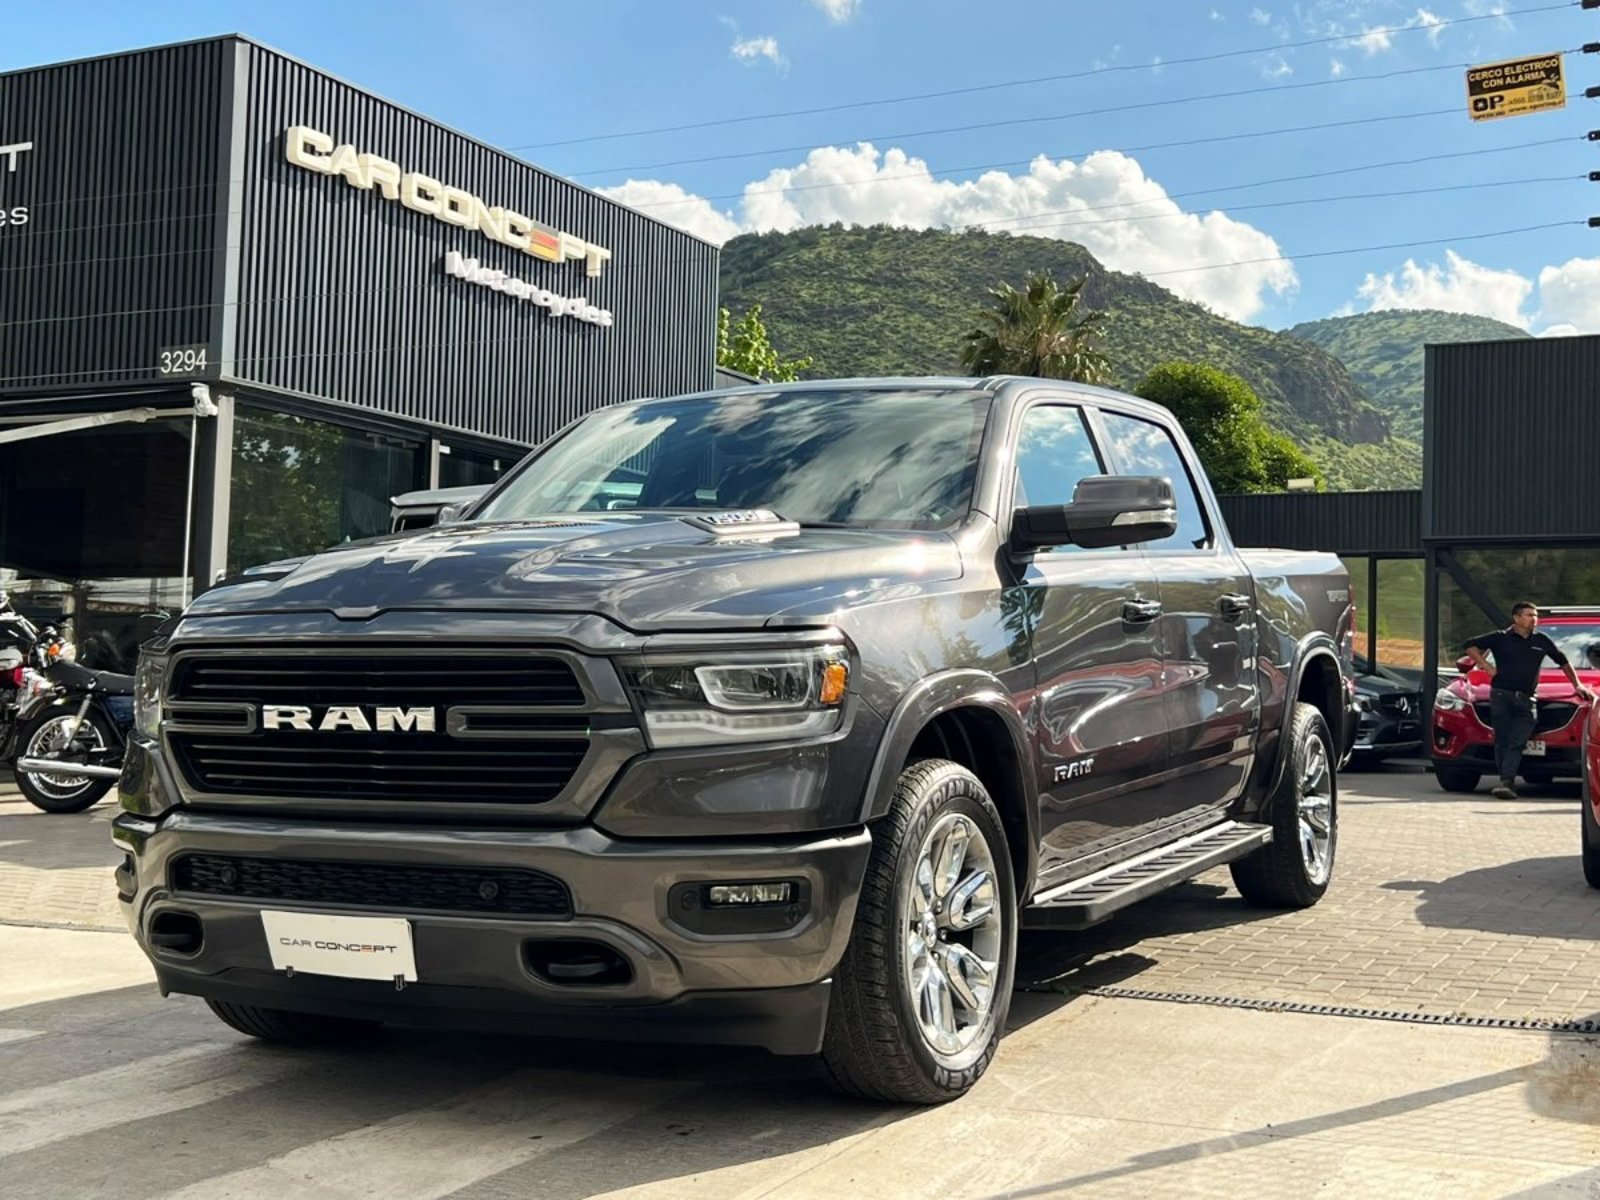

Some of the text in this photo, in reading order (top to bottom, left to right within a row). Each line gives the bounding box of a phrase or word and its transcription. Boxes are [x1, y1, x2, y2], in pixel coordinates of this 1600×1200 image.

[1468, 59, 1558, 82] CERCO ELECTRICO
[1482, 71, 1546, 89] CON ALARMA
[445, 250, 613, 327] Motorcycles
[160, 348, 208, 374] 3294
[262, 704, 436, 732] RAM
[1054, 758, 1094, 783] RAM
[279, 937, 398, 953] CAR CONCEPT
